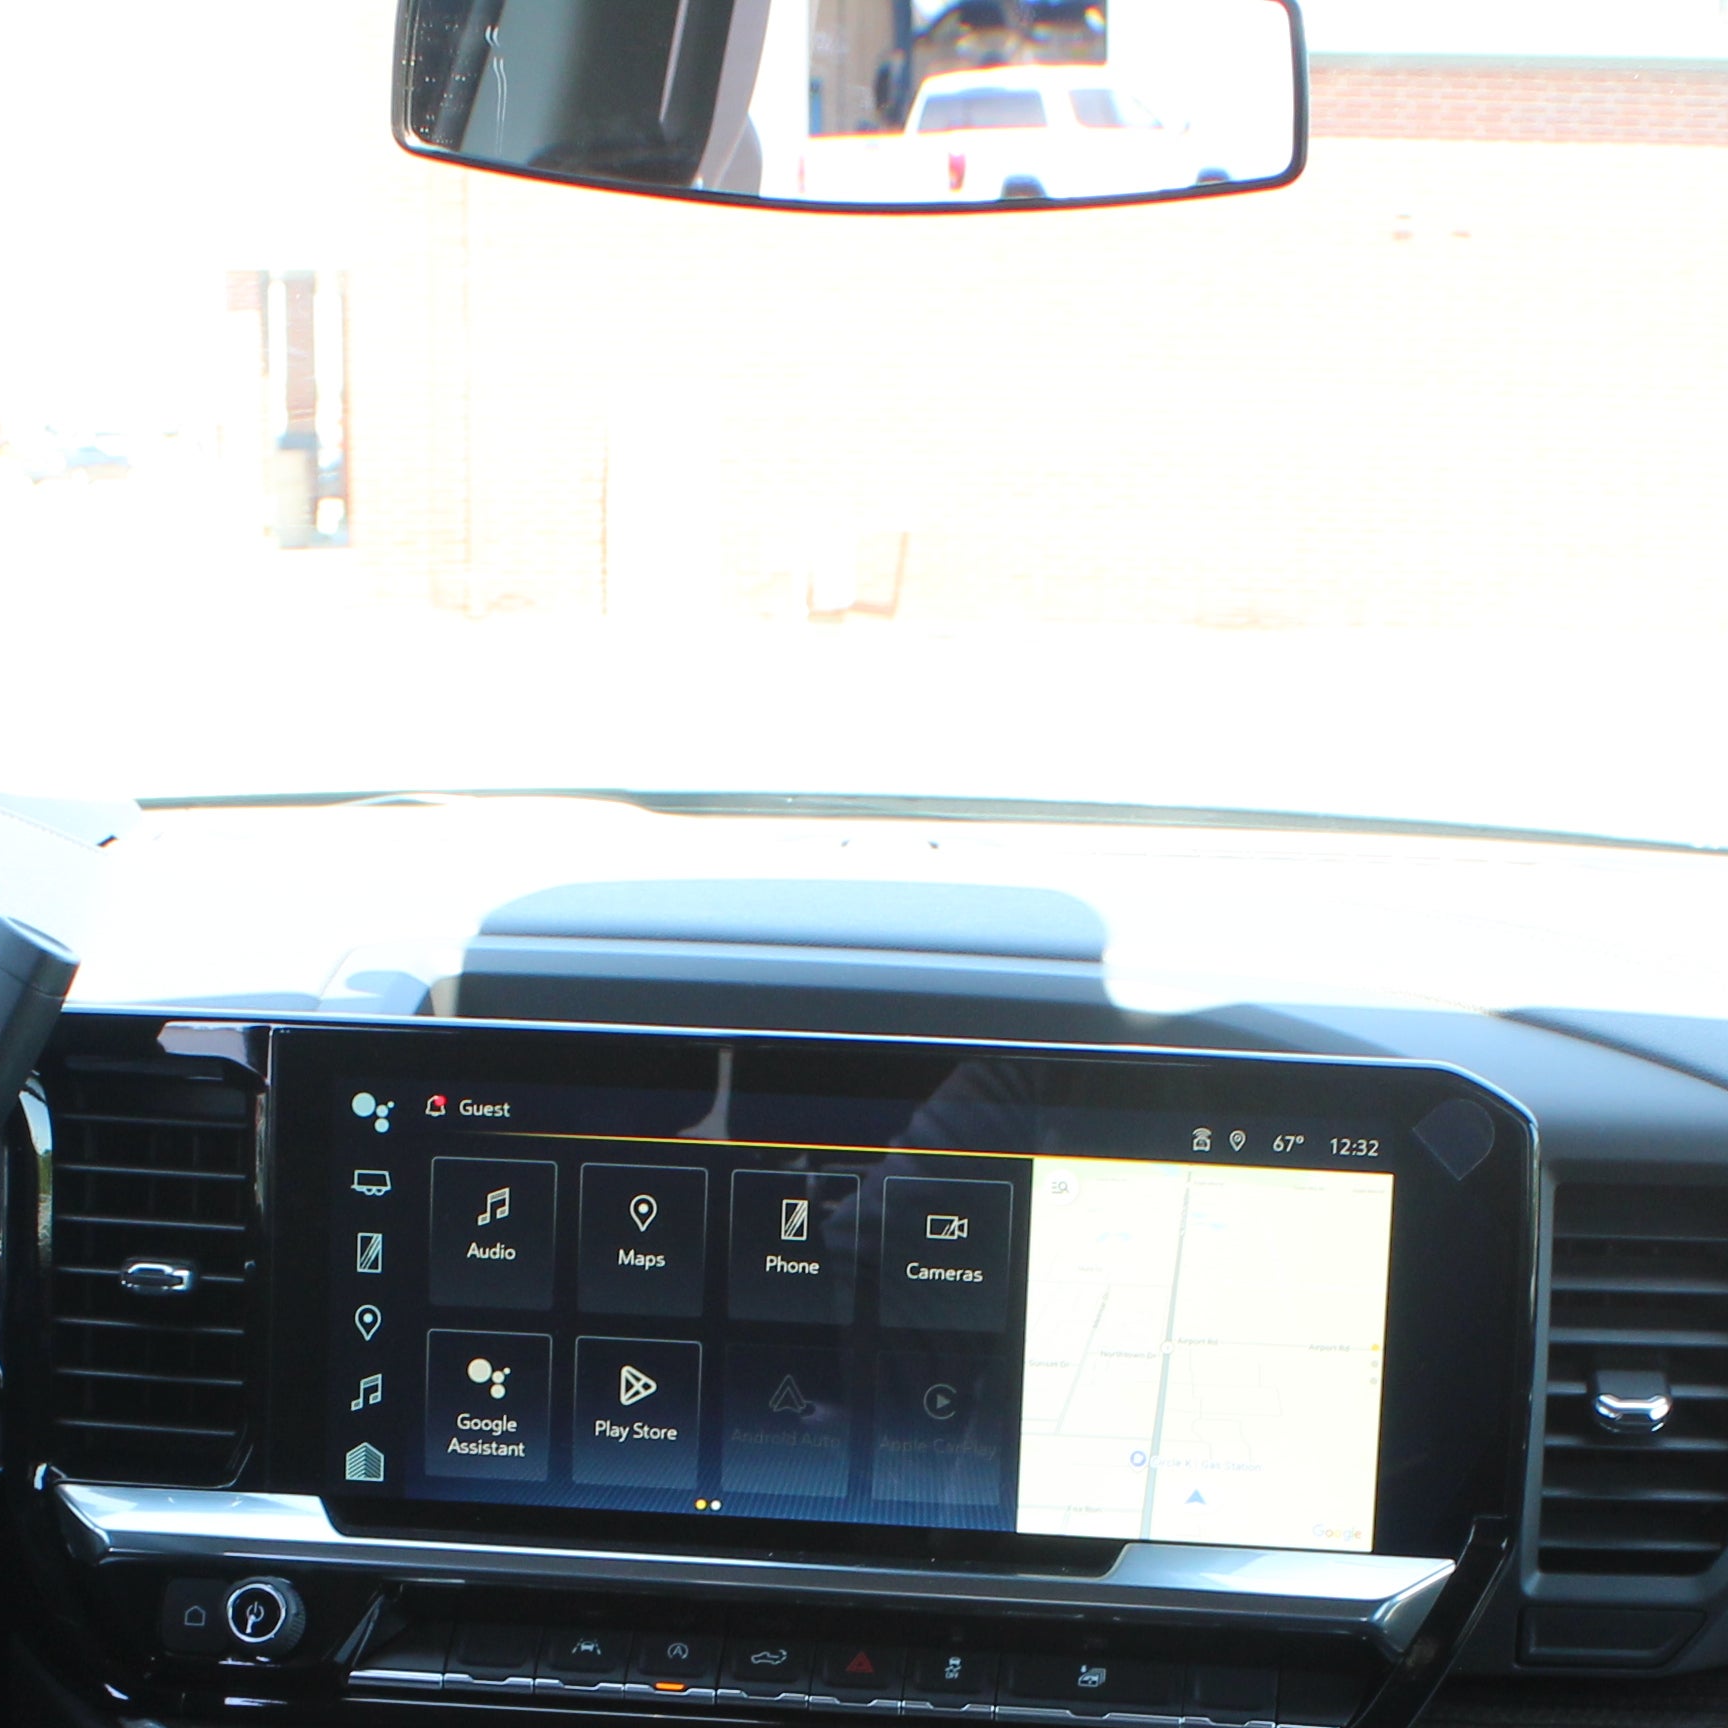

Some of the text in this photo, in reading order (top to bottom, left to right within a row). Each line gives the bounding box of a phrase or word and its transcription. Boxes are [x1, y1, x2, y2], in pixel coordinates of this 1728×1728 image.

[459, 1100, 510, 1119] Guest
[1329, 1138, 1380, 1157] 12:32
[467, 1243, 516, 1261] Audio
[618, 1250, 666, 1271] Maps
[765, 1256, 820, 1276] Phone
[906, 1263, 984, 1283] Cameras
[1177, 1337, 1207, 1347] Airport
[1308, 1343, 1337, 1353] Airport
[457, 1414, 517, 1437] Google
[595, 1421, 678, 1443] Play Store
[731, 1428, 840, 1449] Android Auto
[880, 1435, 927, 1454] Apple
[448, 1438, 525, 1459] Assistant
[1224, 1461, 1262, 1472] Station
[1312, 1524, 1362, 1542] Google
